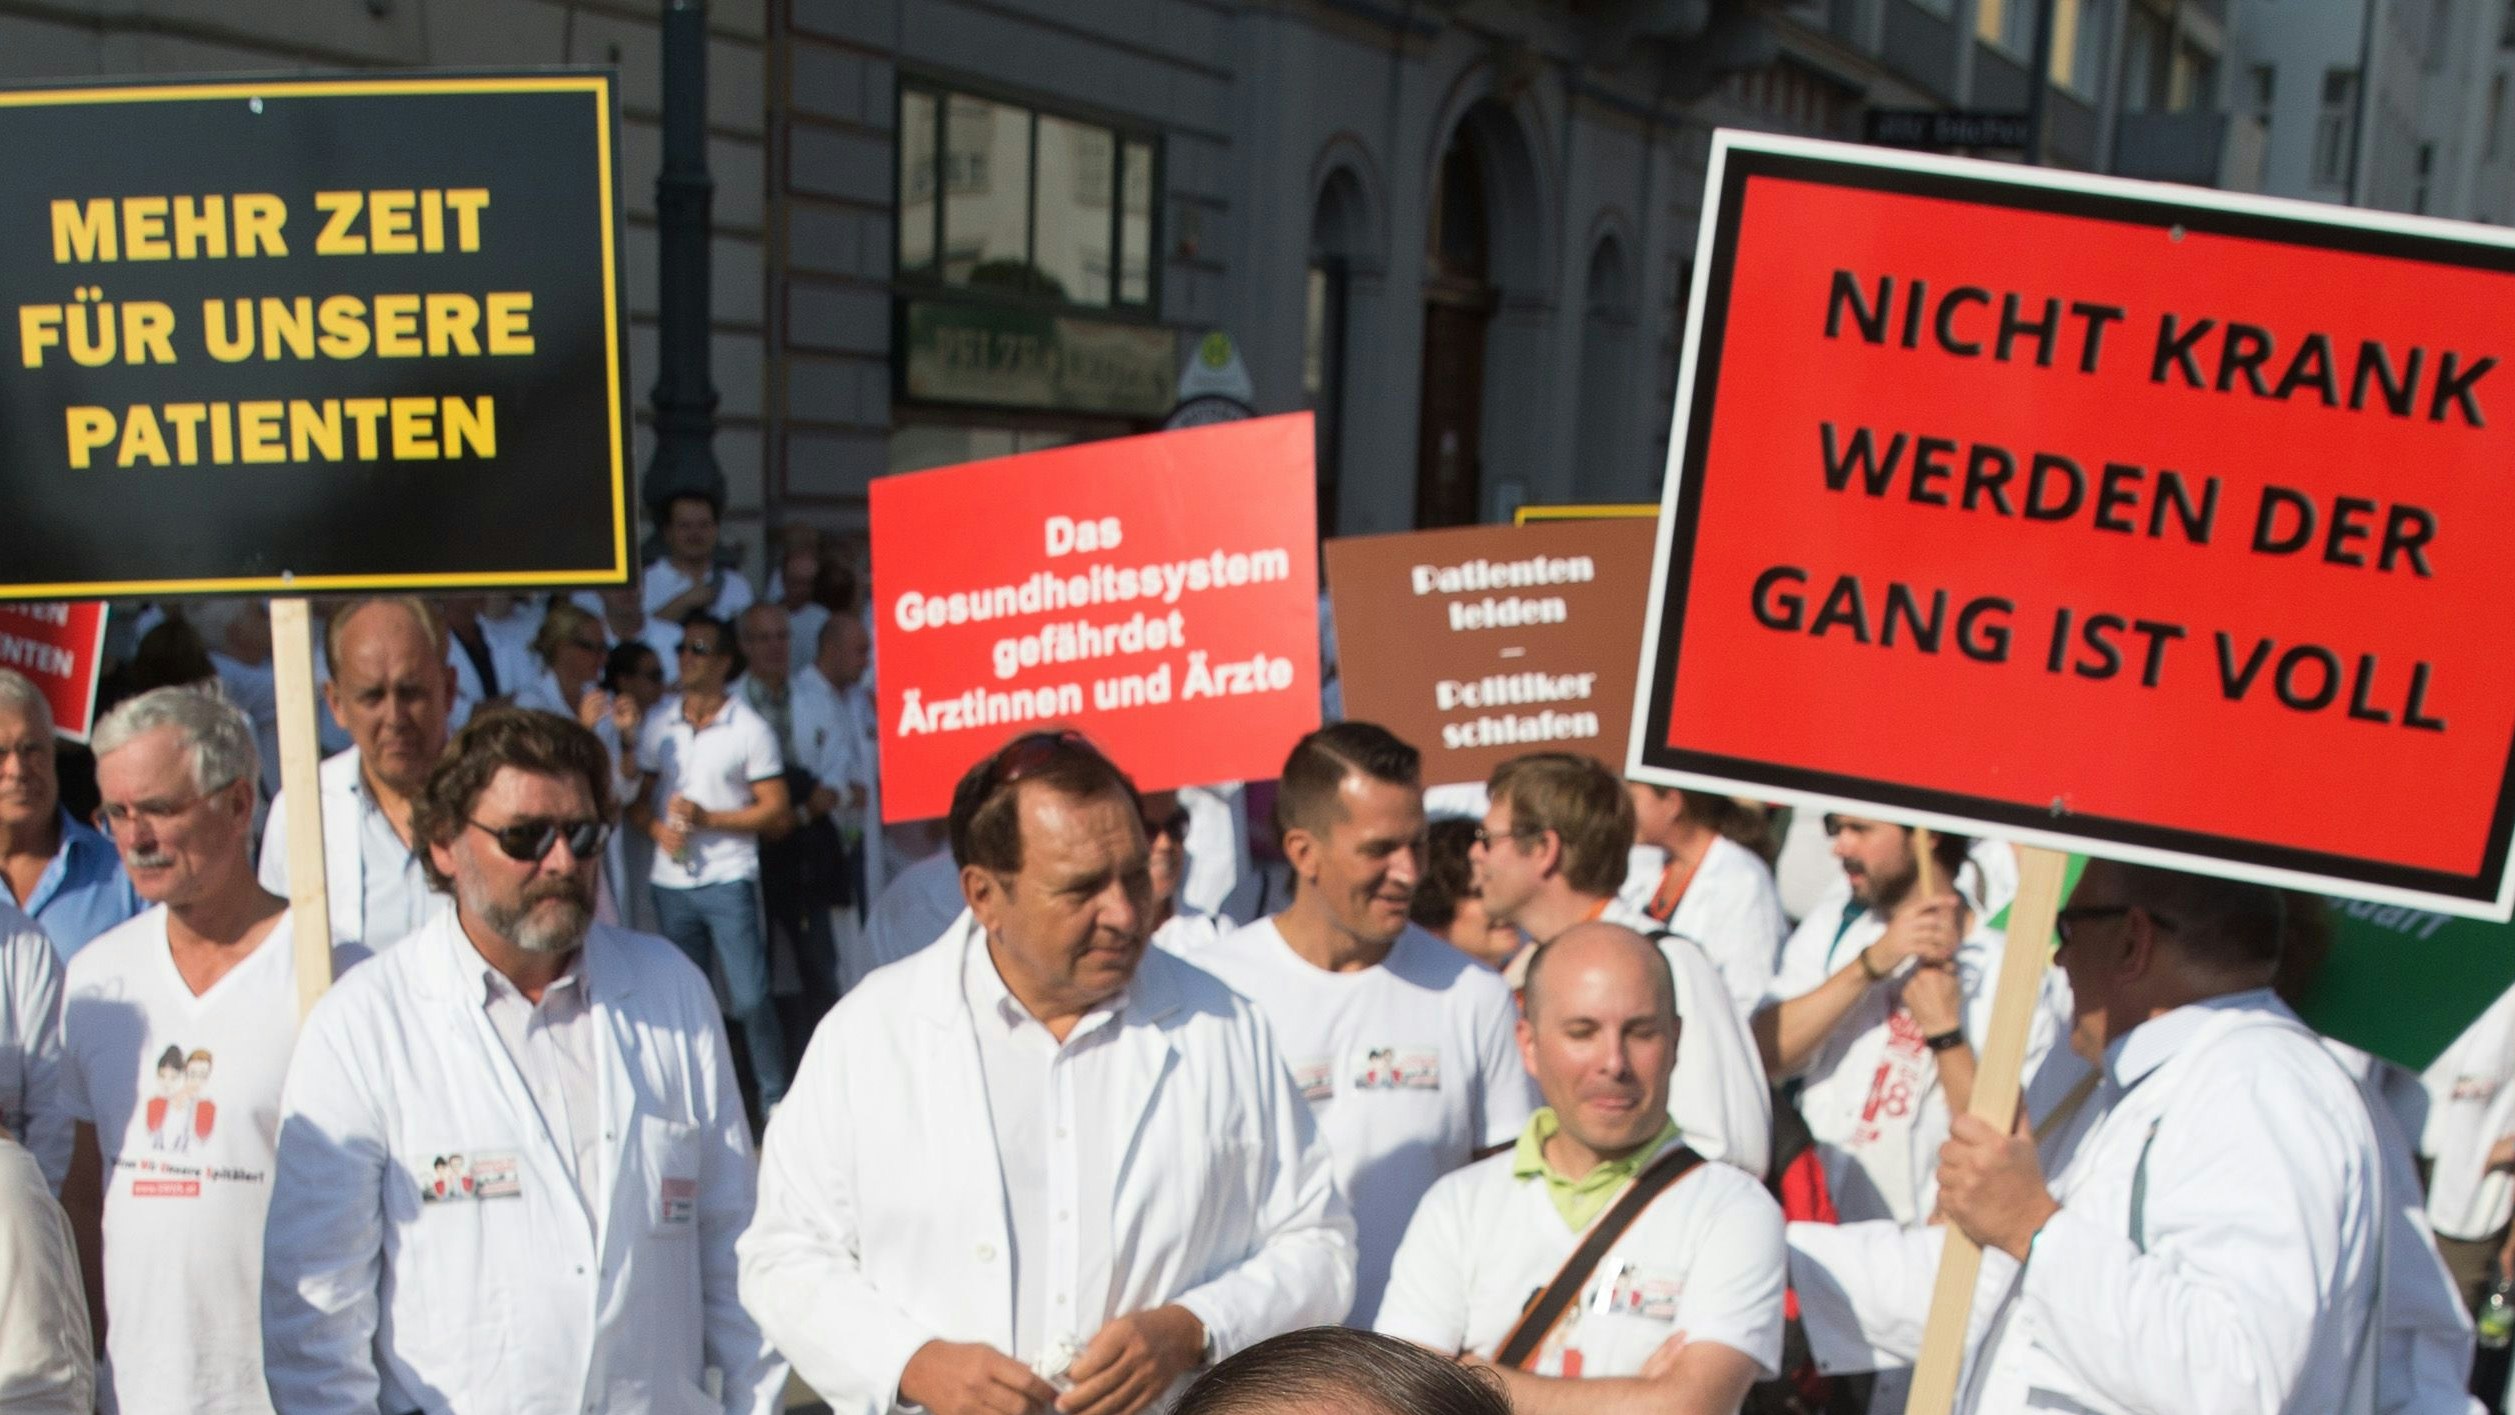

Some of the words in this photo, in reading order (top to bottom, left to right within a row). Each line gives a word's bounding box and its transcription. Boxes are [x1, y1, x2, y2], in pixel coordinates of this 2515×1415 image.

[51, 193, 289, 262] MEHR
[315, 189, 489, 254] ZEIT
[19, 286, 176, 368] FÜR
[203, 292, 535, 362] UNSERE
[1824, 270, 2125, 375] NICHT
[2150, 313, 2499, 428] KRANK
[66, 396, 496, 469] PATIENTEN
[1044, 515, 1122, 558] Das
[1820, 422, 2220, 545] WERDEN
[2251, 485, 2437, 578] DER
[894, 541, 1289, 632] Gesundheitssystem
[1411, 555, 1595, 595] Patienten
[992, 608, 1186, 680] gefährdet
[1448, 596, 1567, 631] leiden
[1751, 565, 2015, 663] GANG
[2047, 608, 2187, 688] IST
[2215, 631, 2445, 732] VOLL
[897, 680, 1084, 737] Ärztinnen
[1093, 662, 1171, 711] und
[1180, 649, 1295, 701] Ärzte
[1436, 671, 1597, 711] Politiker
[1442, 709, 1599, 749] schlafen
